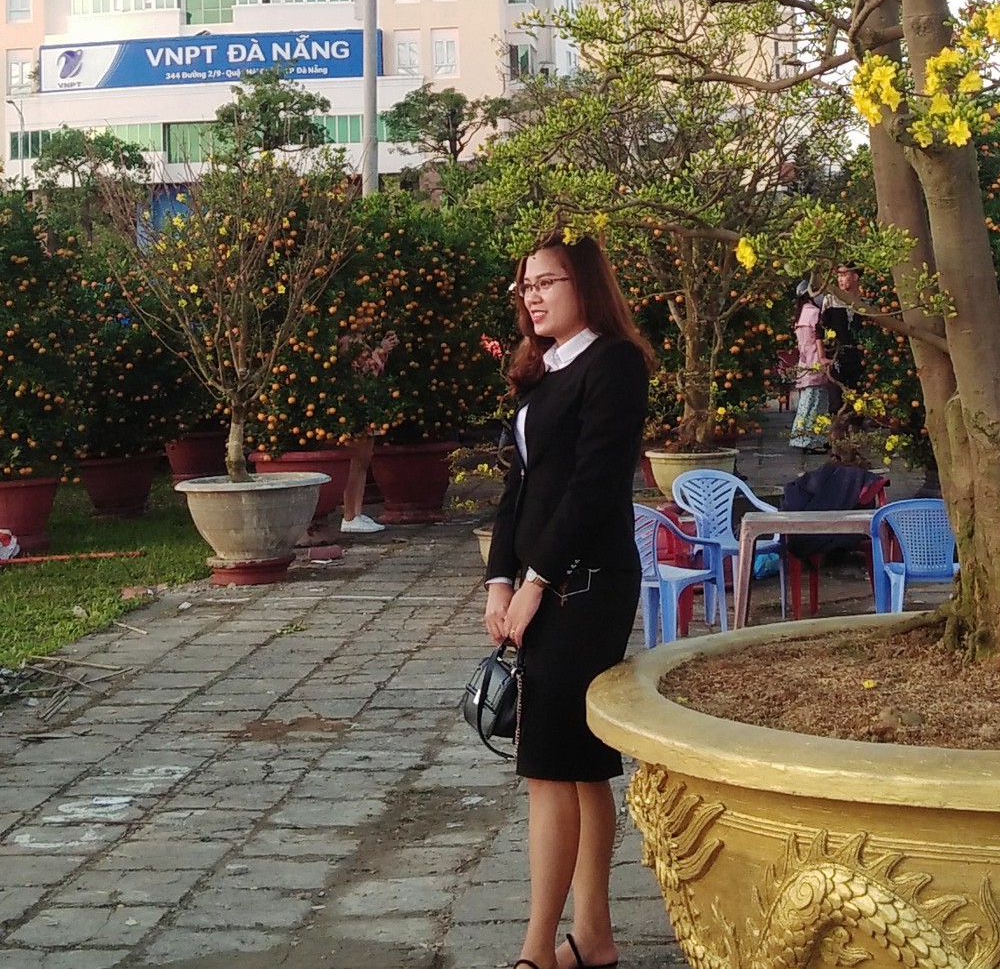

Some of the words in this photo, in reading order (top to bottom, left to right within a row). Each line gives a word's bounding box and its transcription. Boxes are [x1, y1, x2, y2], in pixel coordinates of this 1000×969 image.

[145, 44, 217, 67] VNPT
[226, 38, 265, 63] ĐÀ
[272, 35, 350, 61] NẴNG
[165, 72, 180, 80] 344
[207, 69, 221, 79] 2/9
